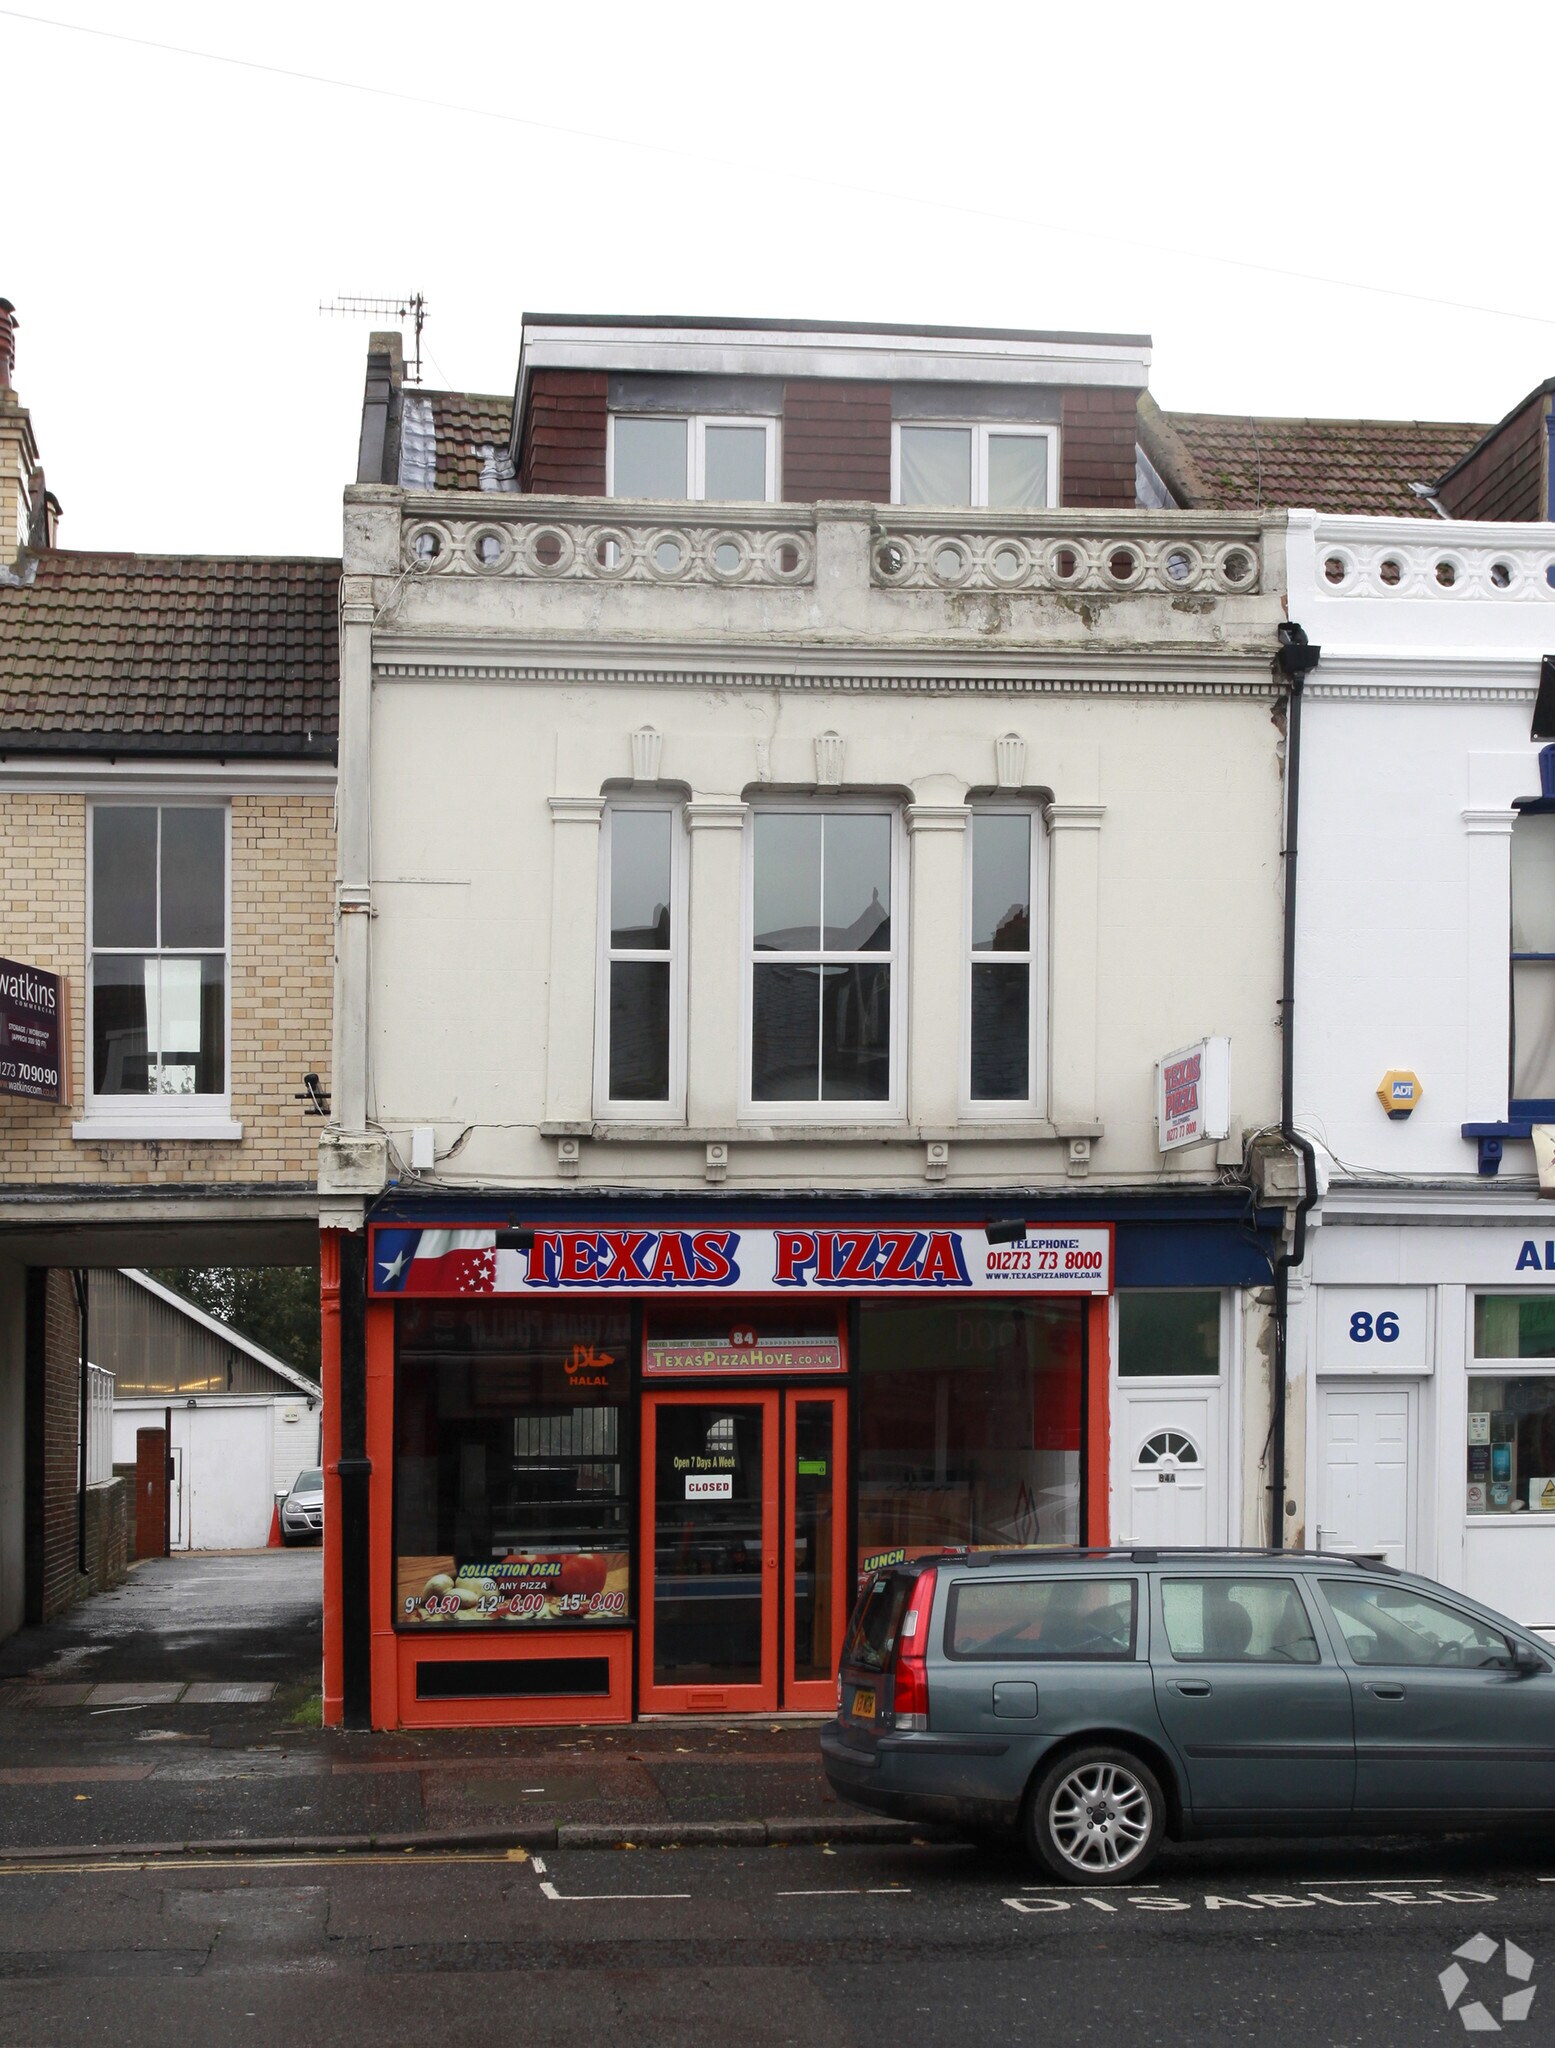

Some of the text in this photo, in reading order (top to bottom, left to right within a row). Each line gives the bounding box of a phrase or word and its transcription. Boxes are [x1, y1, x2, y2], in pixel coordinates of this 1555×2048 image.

[0, 973, 56, 1008] watkins
[15, 1000, 56, 1016] COMMERCIAL
[18, 1062, 58, 1086] 709090
[1164, 1053, 1202, 1094] TEXAS
[1393, 1084, 1414, 1097] ADT
[1165, 1083, 1199, 1122] PIZZA
[517, 1230, 973, 1288] TEXAS PIZZA
[986, 1251, 1103, 1270] 01273 73 8000
[985, 1271, 1103, 1280] WWW.TEXASPIZZAHOVE.CO.UK
[1349, 1311, 1400, 1343] 86
[733, 1332, 754, 1345] 84
[569, 1376, 609, 1386] HALAL
[673, 1456, 736, 1471] Open 7 Days A Week
[688, 1482, 730, 1492] CLOSED
[1158, 1473, 1176, 1483] 84A
[863, 1549, 906, 1573] LUNCH
[458, 1562, 563, 1579] COLLECTION DEAL
[483, 1582, 548, 1591] ON ANY PIZZA
[425, 1595, 461, 1614] 4.50
[509, 1593, 545, 1613] 6.00
[589, 1592, 626, 1612] 8.00
[1001, 1890, 1500, 1913] DISABLED
